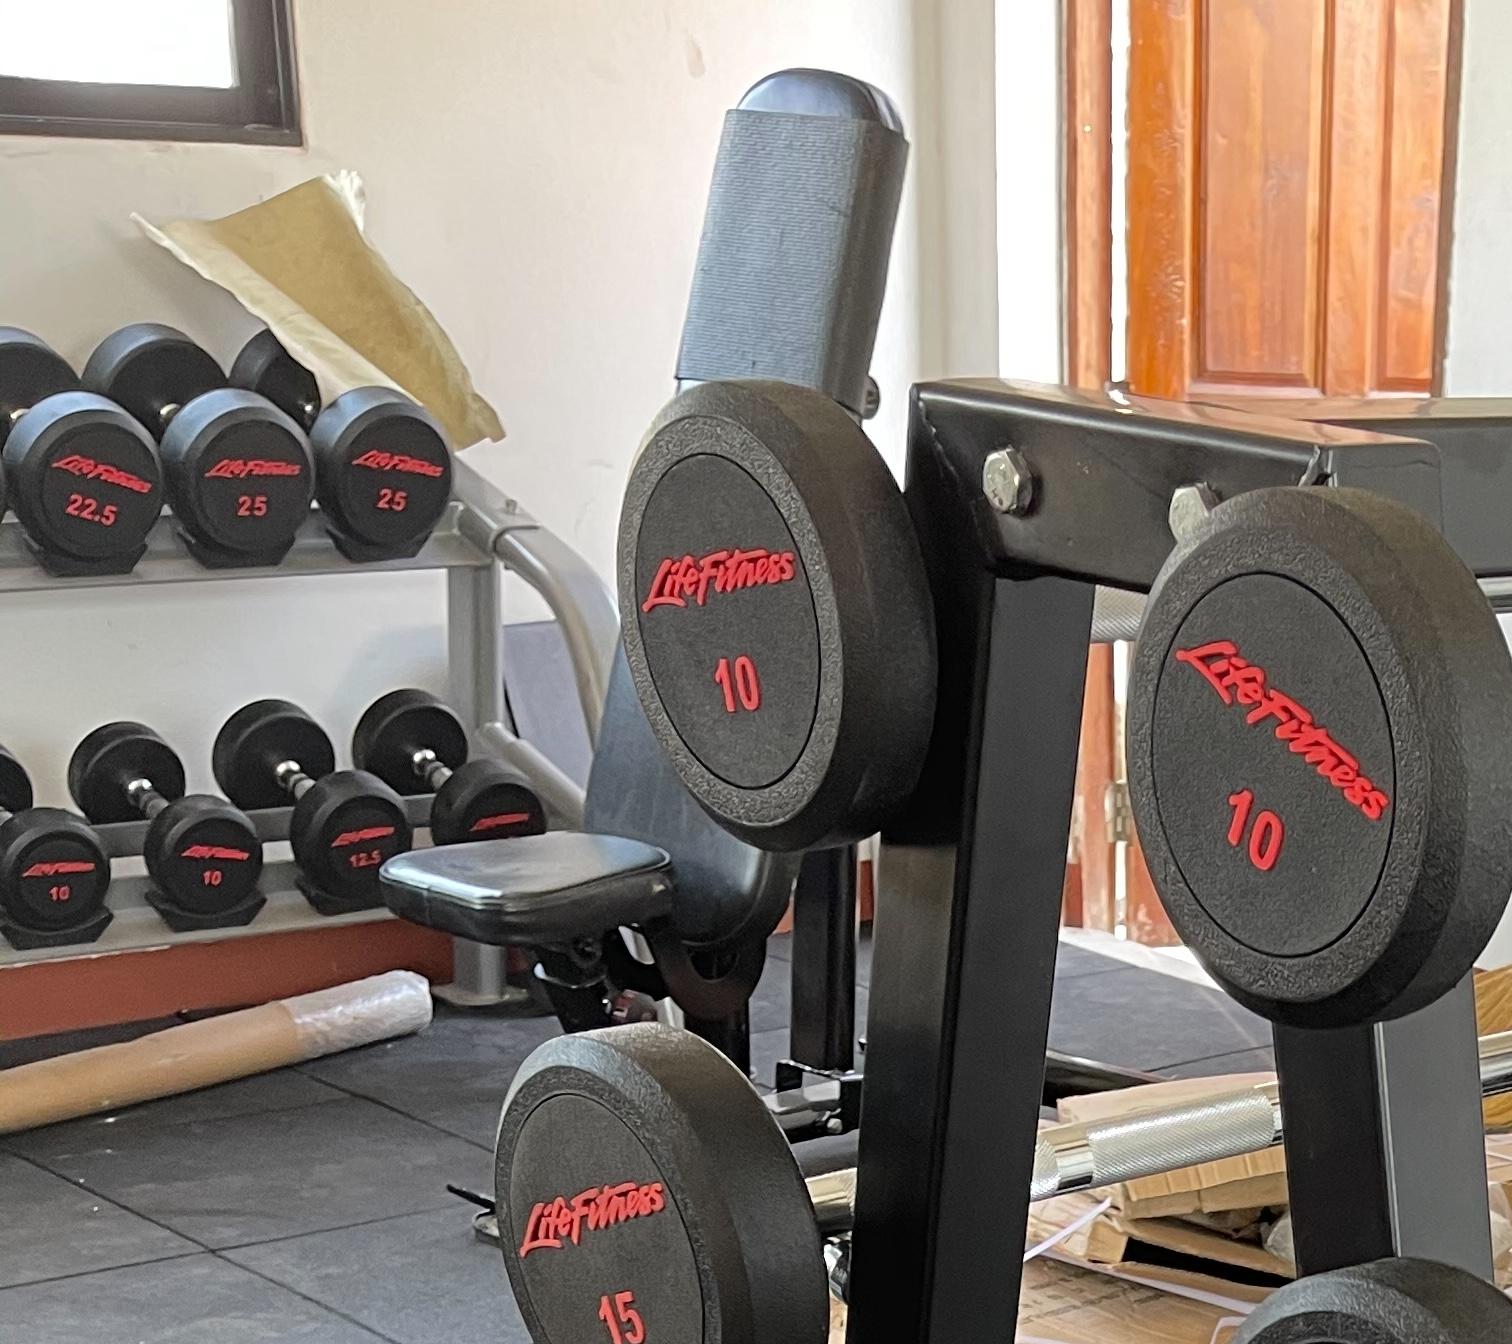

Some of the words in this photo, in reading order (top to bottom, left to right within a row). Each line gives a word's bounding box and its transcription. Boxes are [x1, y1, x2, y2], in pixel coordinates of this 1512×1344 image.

[66, 493, 117, 525] 22.5
[238, 495, 266, 517] 25
[377, 488, 406, 512] 25
[713, 654, 762, 714] 10
[1226, 788, 1286, 872] 10
[203, 870, 222, 886] 10
[48, 885, 71, 902] 10
